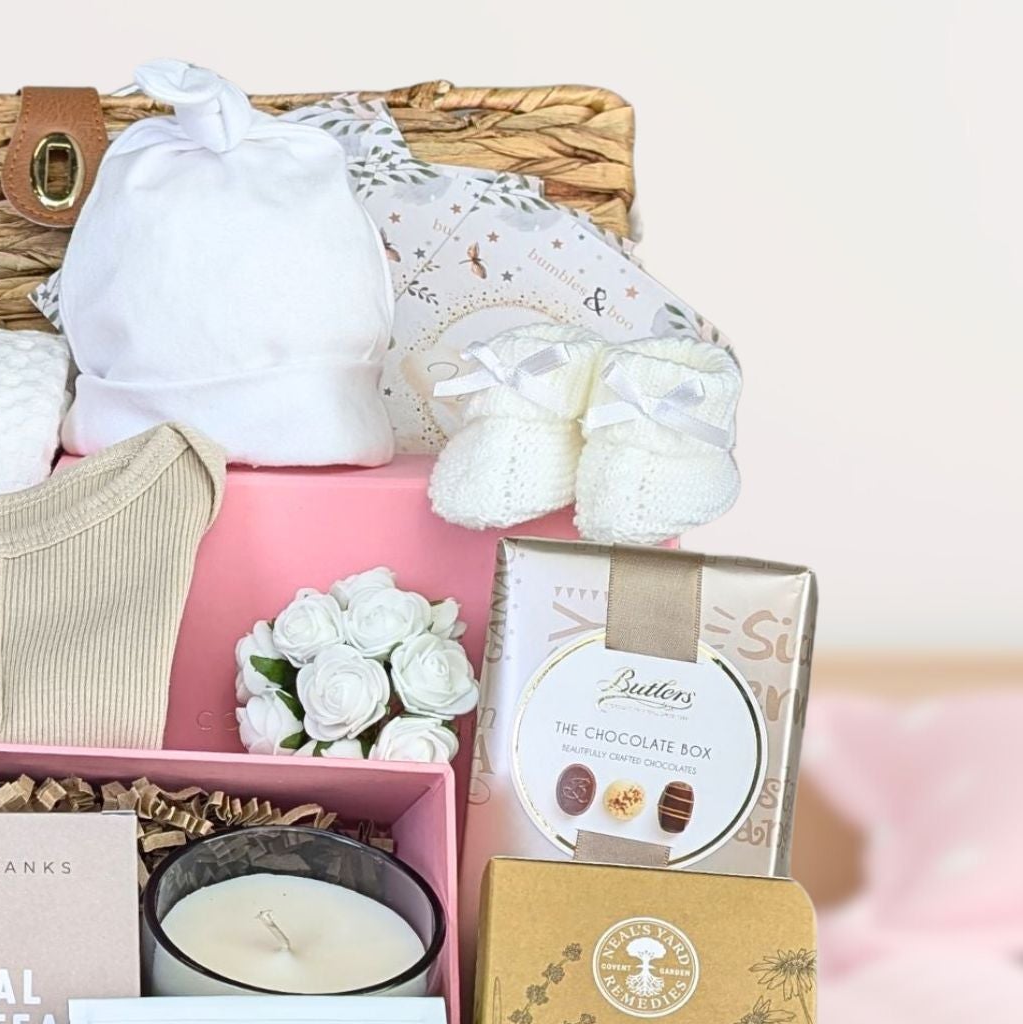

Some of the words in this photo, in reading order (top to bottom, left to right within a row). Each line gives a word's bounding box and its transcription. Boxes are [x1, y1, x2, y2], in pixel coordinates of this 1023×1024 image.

[528, 248, 586, 297] bumbles
[583, 287, 607, 316] &
[607, 305, 634, 331] boo
[596, 667, 696, 704] Butlers
[555, 721, 578, 737] THE
[584, 727, 676, 754] CHOCOLATE
[680, 744, 713, 760] BOX
[561, 744, 608, 758] BEAUTIFULLY
[609, 752, 642, 765] CRAFTED
[643, 759, 697, 775] CHOCOLATES
[602, 924, 652, 959] NEAL'S
[657, 927, 690, 965] YARD
[601, 963, 632, 971] COVENT
[659, 967, 690, 976] GARDEN
[603, 975, 687, 1009] REMEDIES
